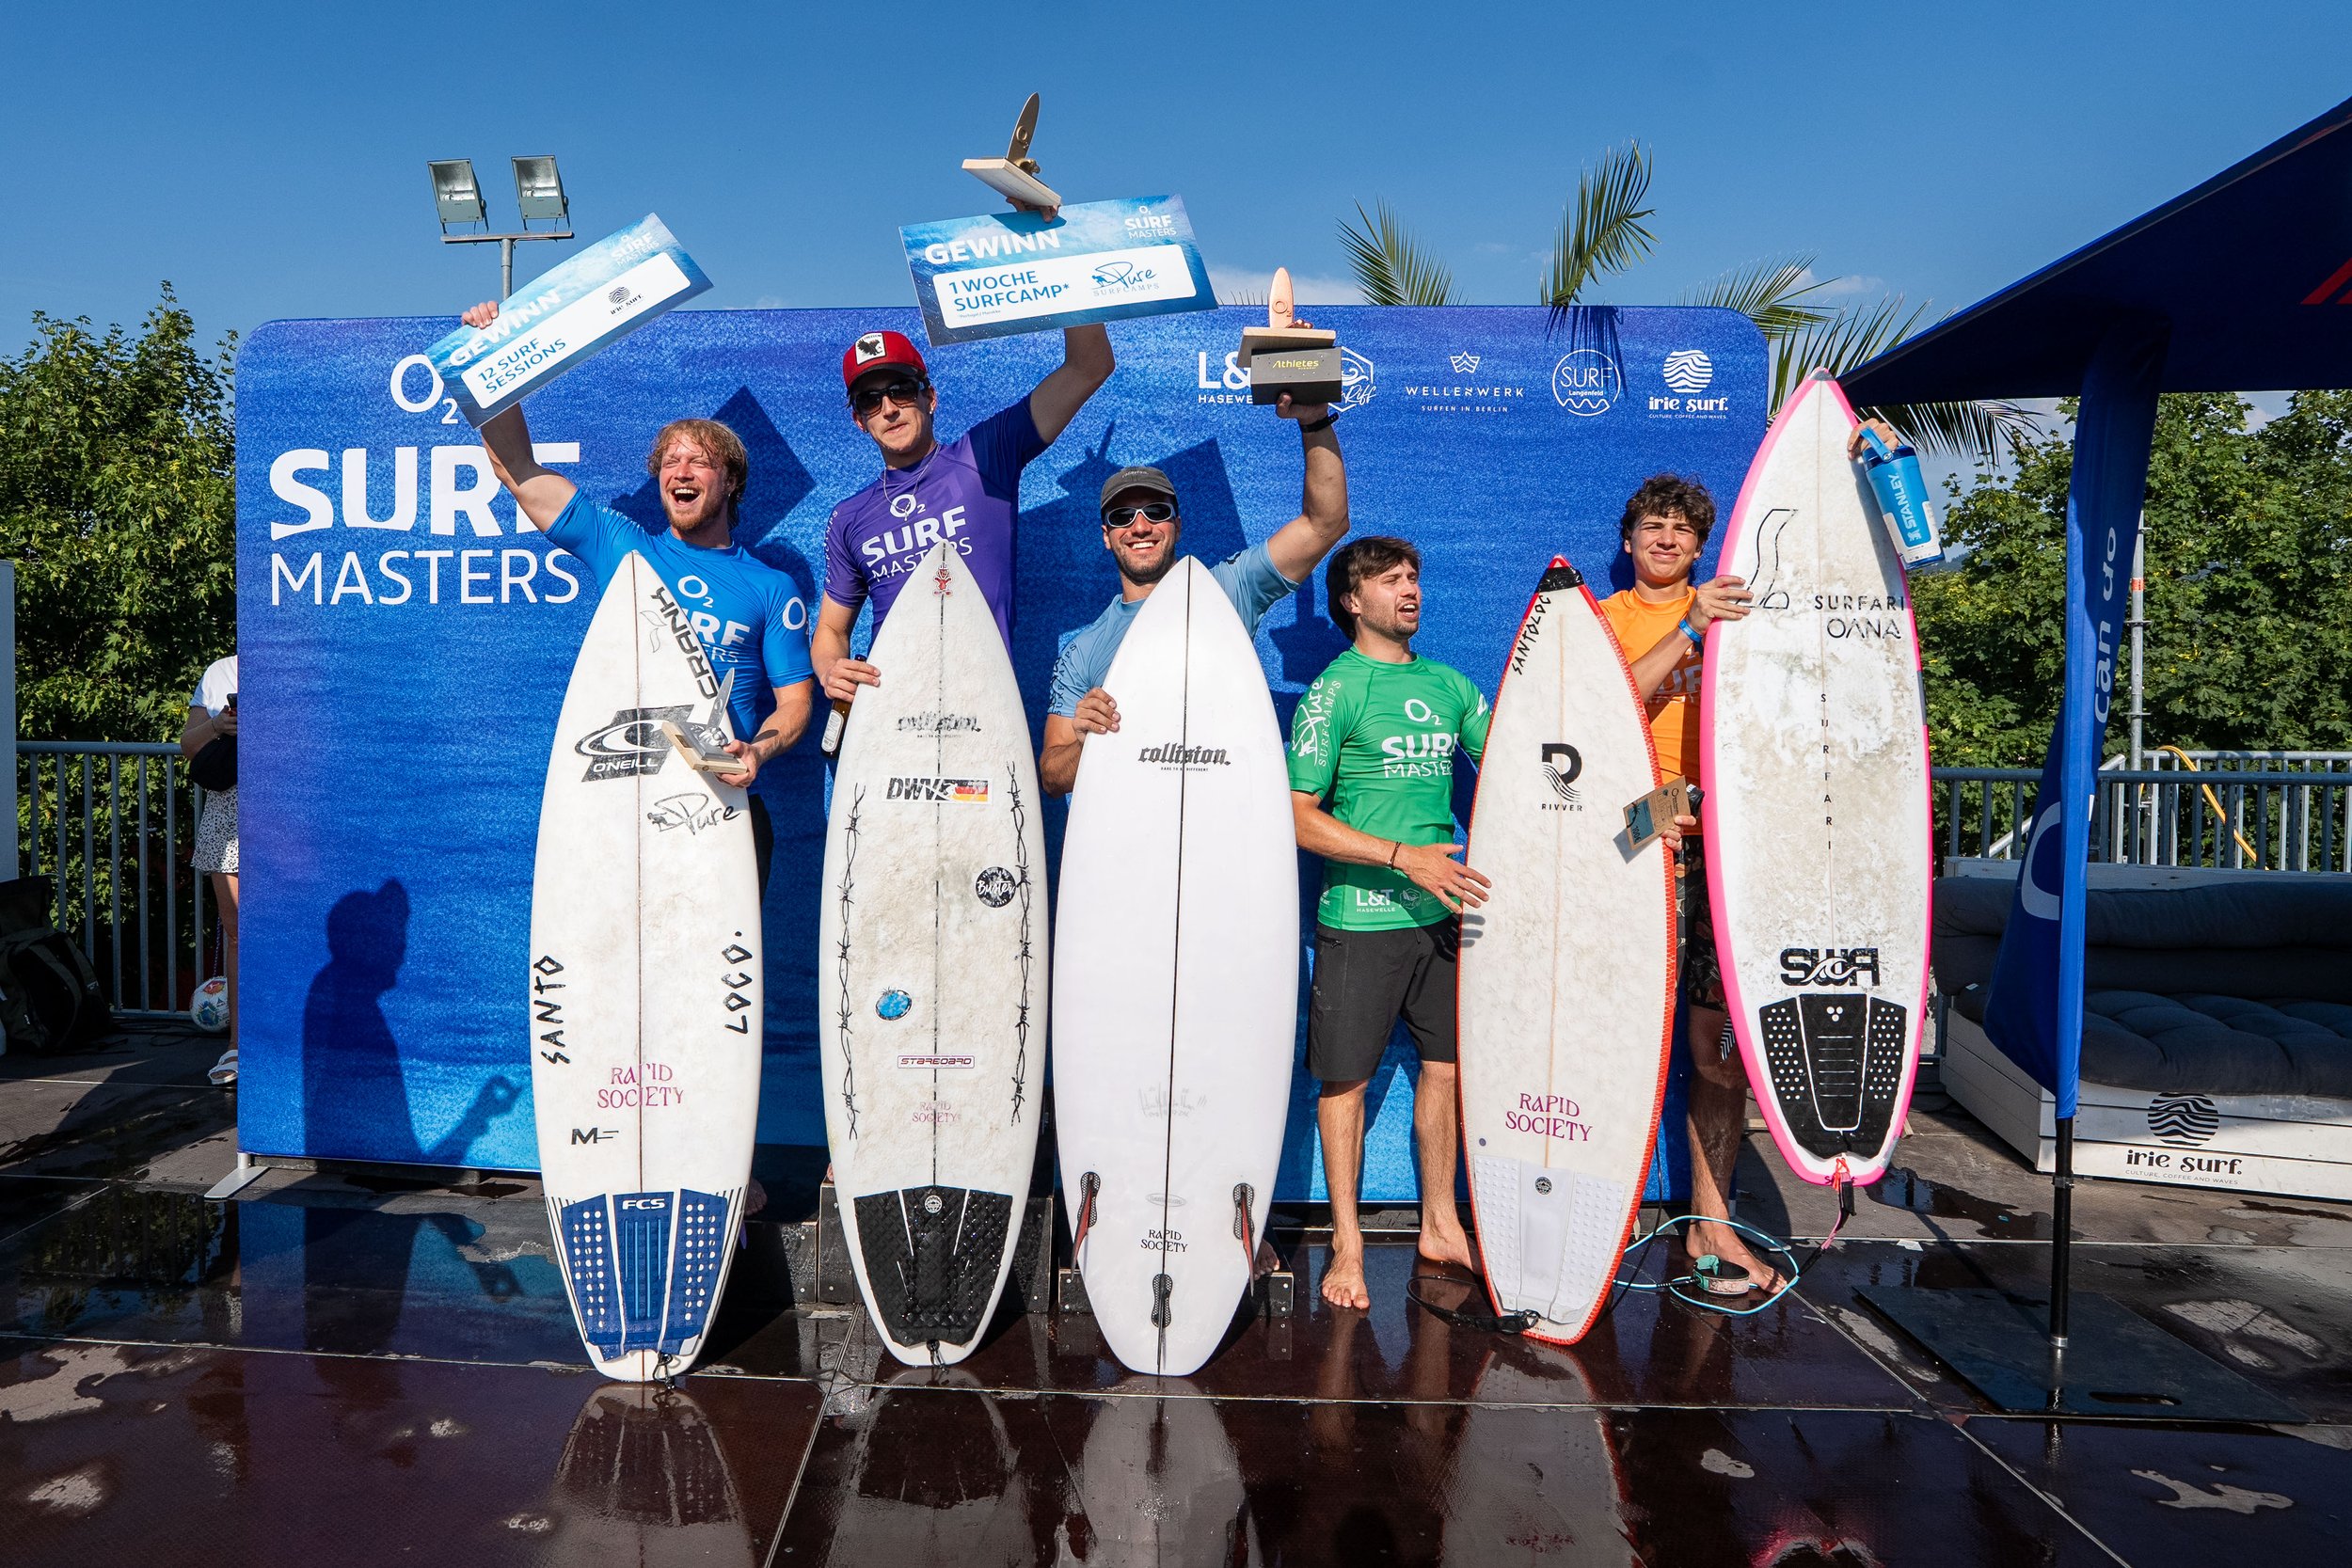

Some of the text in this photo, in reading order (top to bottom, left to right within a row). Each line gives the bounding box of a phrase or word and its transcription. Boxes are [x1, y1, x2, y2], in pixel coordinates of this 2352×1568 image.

[1125, 215, 1171, 230] SURF
[1128, 228, 1177, 239] MASTERS
[611, 232, 653, 258] SURF
[616, 241, 660, 266] MASTERS
[925, 229, 1061, 264] GEWINN
[949, 270, 1039, 294] 1 WOCHE
[1095, 261, 1157, 289] Pure
[450, 288, 562, 366] GEWINN
[478, 338, 539, 381] 12 SURF
[485, 339, 566, 393] SESSIONS
[1199, 352, 1251, 389] L&
[1560, 367, 1613, 388] SURF
[1199, 394, 1252, 404] HASEWE
[1406, 387, 1524, 397] WELLENWERK
[1648, 397, 1728, 412] irie surf.
[1888, 472, 1917, 530] STANLEY
[862, 505, 966, 567] SURF
[872, 537, 973, 582] MASTS
[272, 548, 580, 606] MASTERS
[1815, 595, 1904, 611] SURFARI
[686, 609, 750, 645] RF
[2094, 527, 2117, 724] can do
[1318, 680, 1342, 767] SURFCAMPS
[594, 758, 659, 772] O'NEILL
[1138, 742, 1232, 766] collision.
[654, 792, 739, 835] Pure
[1541, 802, 1583, 812] RIVVER
[1356, 889, 1394, 907] L&T
[533, 956, 570, 1064] SANTO
[611, 1063, 673, 1085] RAPID
[597, 1086, 684, 1109] SOCIETY
[1518, 1092, 1581, 1117] RAPID
[1505, 1111, 1593, 1142] SOCIETY
[2126, 1149, 2243, 1176] irie surf.
[622, 1198, 665, 1211] FCS
[1141, 1239, 1188, 1252] SOCIETY
[1149, 1229, 1182, 1241] RAPID
